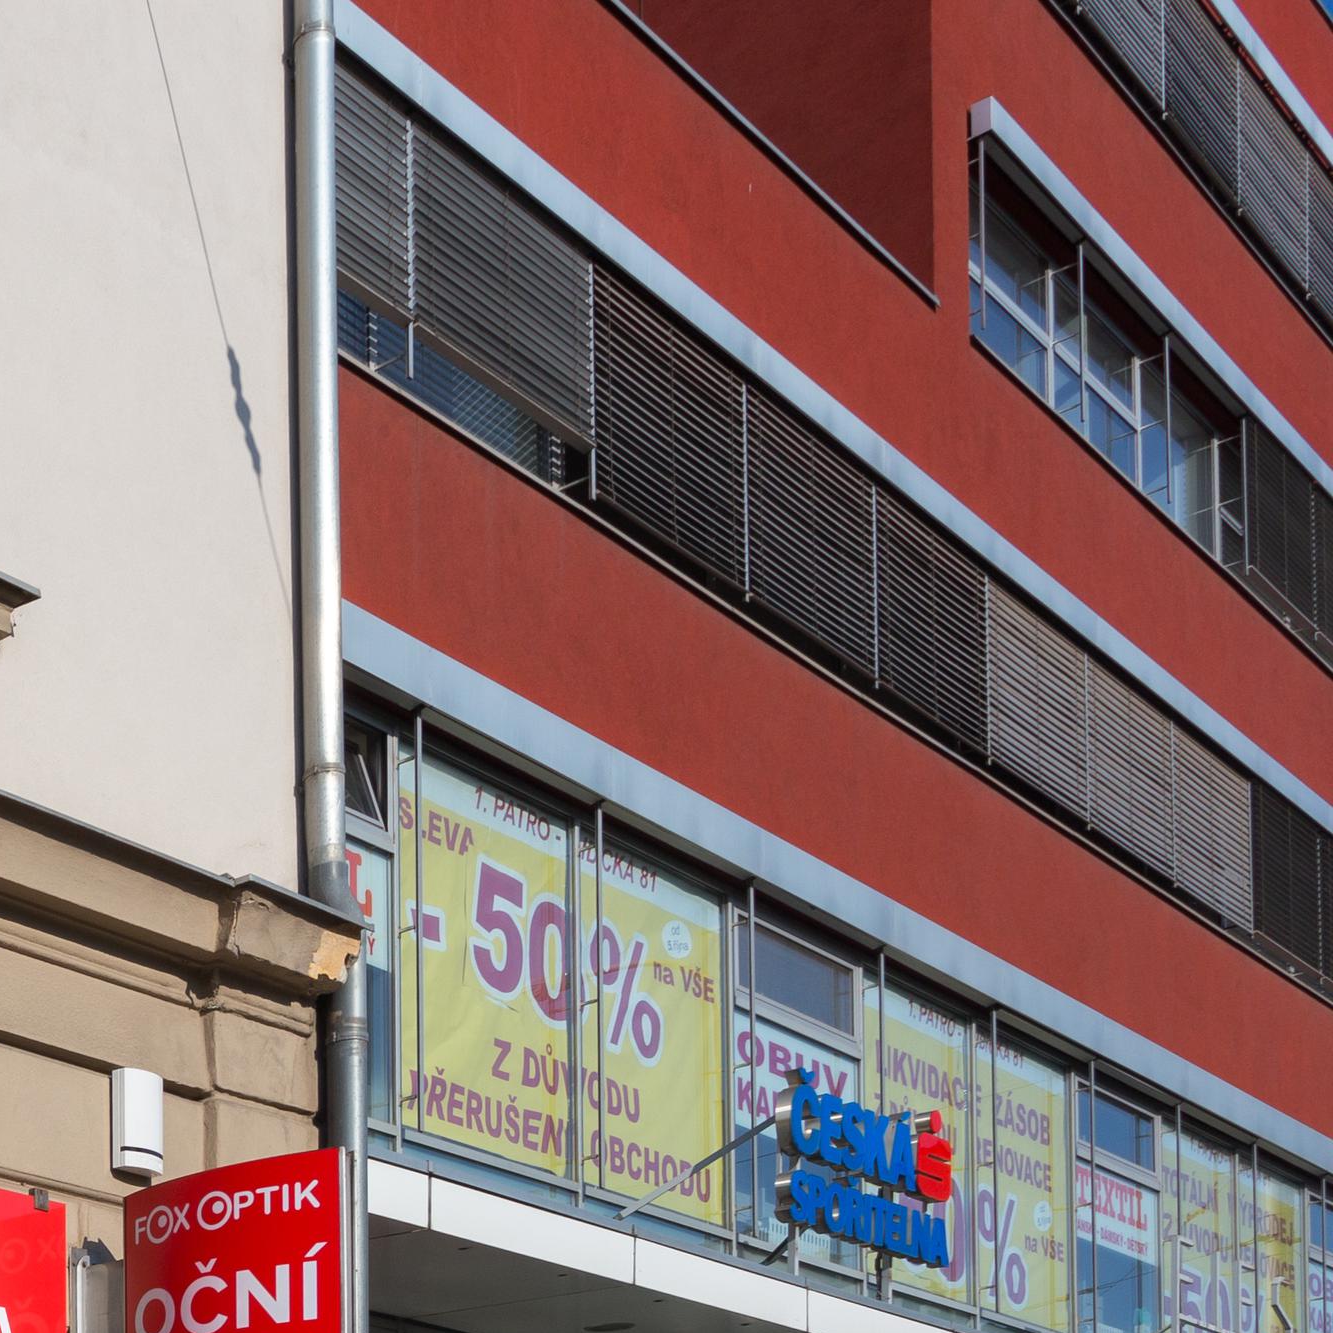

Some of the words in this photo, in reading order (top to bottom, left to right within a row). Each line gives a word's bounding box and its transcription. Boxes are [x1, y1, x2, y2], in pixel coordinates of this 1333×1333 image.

[494, 795, 550, 841] PATRO
[653, 961, 674, 986] na
[680, 965, 715, 1003] VŠE
[491, 1037, 512, 1081] Z
[790, 1067, 917, 1192] ČESKÁ
[995, 1091, 1051, 1147] ZÁSOB
[591, 1130, 711, 1203] OBCHODU
[134, 1203, 191, 1245] FOX
[196, 1179, 321, 1231] OPTIK
[789, 1169, 949, 1268] SPOŘITELNA
[1076, 1164, 1148, 1231] TEXTIL
[1024, 1234, 1038, 1254] na
[1042, 1235, 1065, 1263] VŠE
